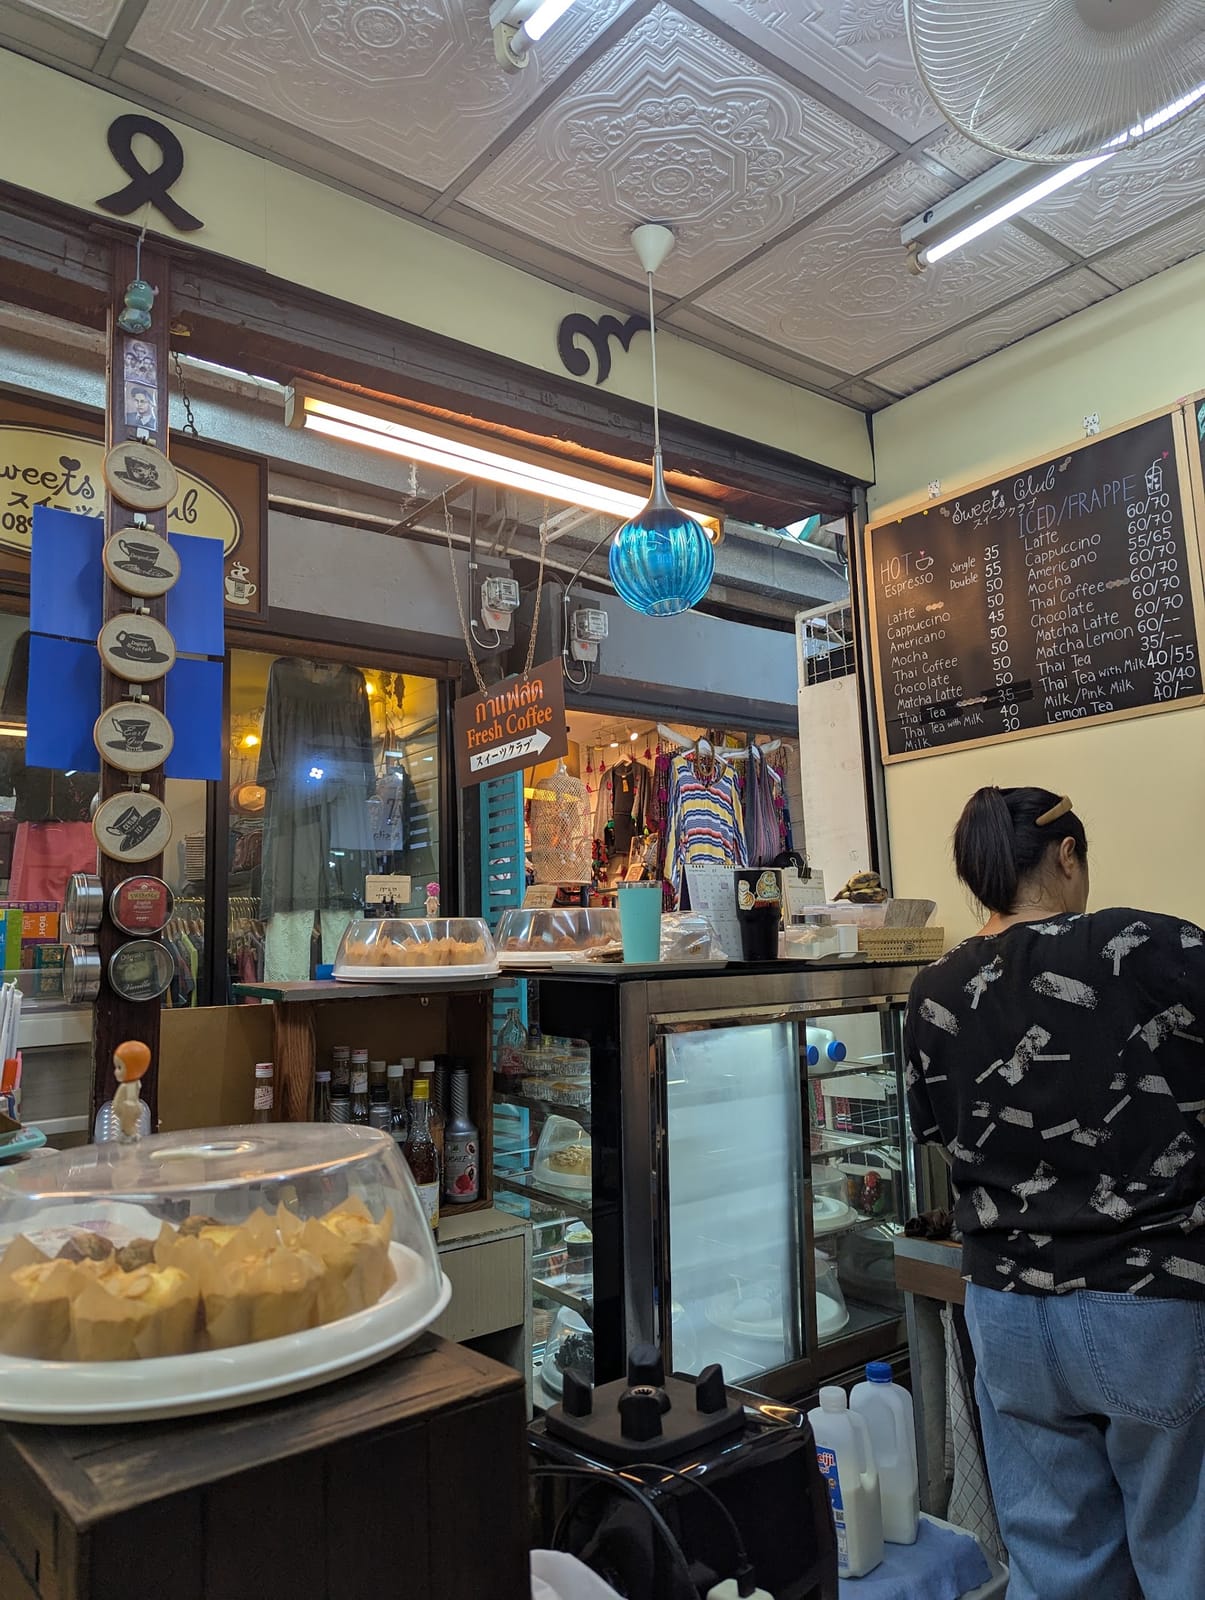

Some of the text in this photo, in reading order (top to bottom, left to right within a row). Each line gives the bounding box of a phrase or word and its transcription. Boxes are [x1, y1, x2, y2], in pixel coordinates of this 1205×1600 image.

[0, 458, 95, 500] weets
[952, 464, 1056, 525] Sweets Club
[973, 497, 1037, 530] スイーツクラブ
[1018, 473, 1137, 539] ICED/FRAPPE
[1025, 493, 1170, 551] Latte 60/70
[1025, 510, 1172, 567] Cappuccino 60/70
[1027, 526, 1172, 582] Americano 55/65
[880, 552, 912, 584] HOT
[885, 544, 999, 598] Espresso Single 35
[950, 561, 1001, 590] Double 55
[1027, 541, 1176, 596] Mocha 60/70
[1030, 558, 1178, 612] Thai Coffee 60/70
[887, 577, 1003, 626] Latte 50
[887, 593, 1004, 640] Cappuccino 50
[1031, 575, 1180, 628] Chocolate 60/70
[1035, 593, 1184, 644] Matcha Latte 60/70
[889, 608, 1005, 654] Americano 45
[891, 625, 1007, 668] Mocha 50
[1035, 638, 1084, 661] Matcha
[1086, 625, 1134, 648] Lemon
[892, 640, 1009, 682] Thai Coffee 50
[894, 656, 1011, 697] Chocolate 50
[1036, 661, 1065, 677] Thai
[1071, 653, 1091, 667] Tea
[1039, 644, 1195, 693] Thai Tea with Milk 40/55
[1109, 679, 1135, 695] Milk
[1152, 666, 1196, 686] 30/40
[475, 679, 543, 723] กาแฟสด
[897, 672, 1013, 711] Matcha Latte 50
[898, 688, 1015, 725] Thai Tea 35
[1046, 706, 1087, 723] Lemon
[1090, 700, 1114, 712] Tea
[466, 704, 553, 749] Fresh Coffee
[900, 704, 1019, 740] Thai Tea with Milk 40
[904, 718, 1020, 752] Milk 30
[476, 738, 533, 767] スイーツクラブ
[816, 1452, 836, 1467] eiji
